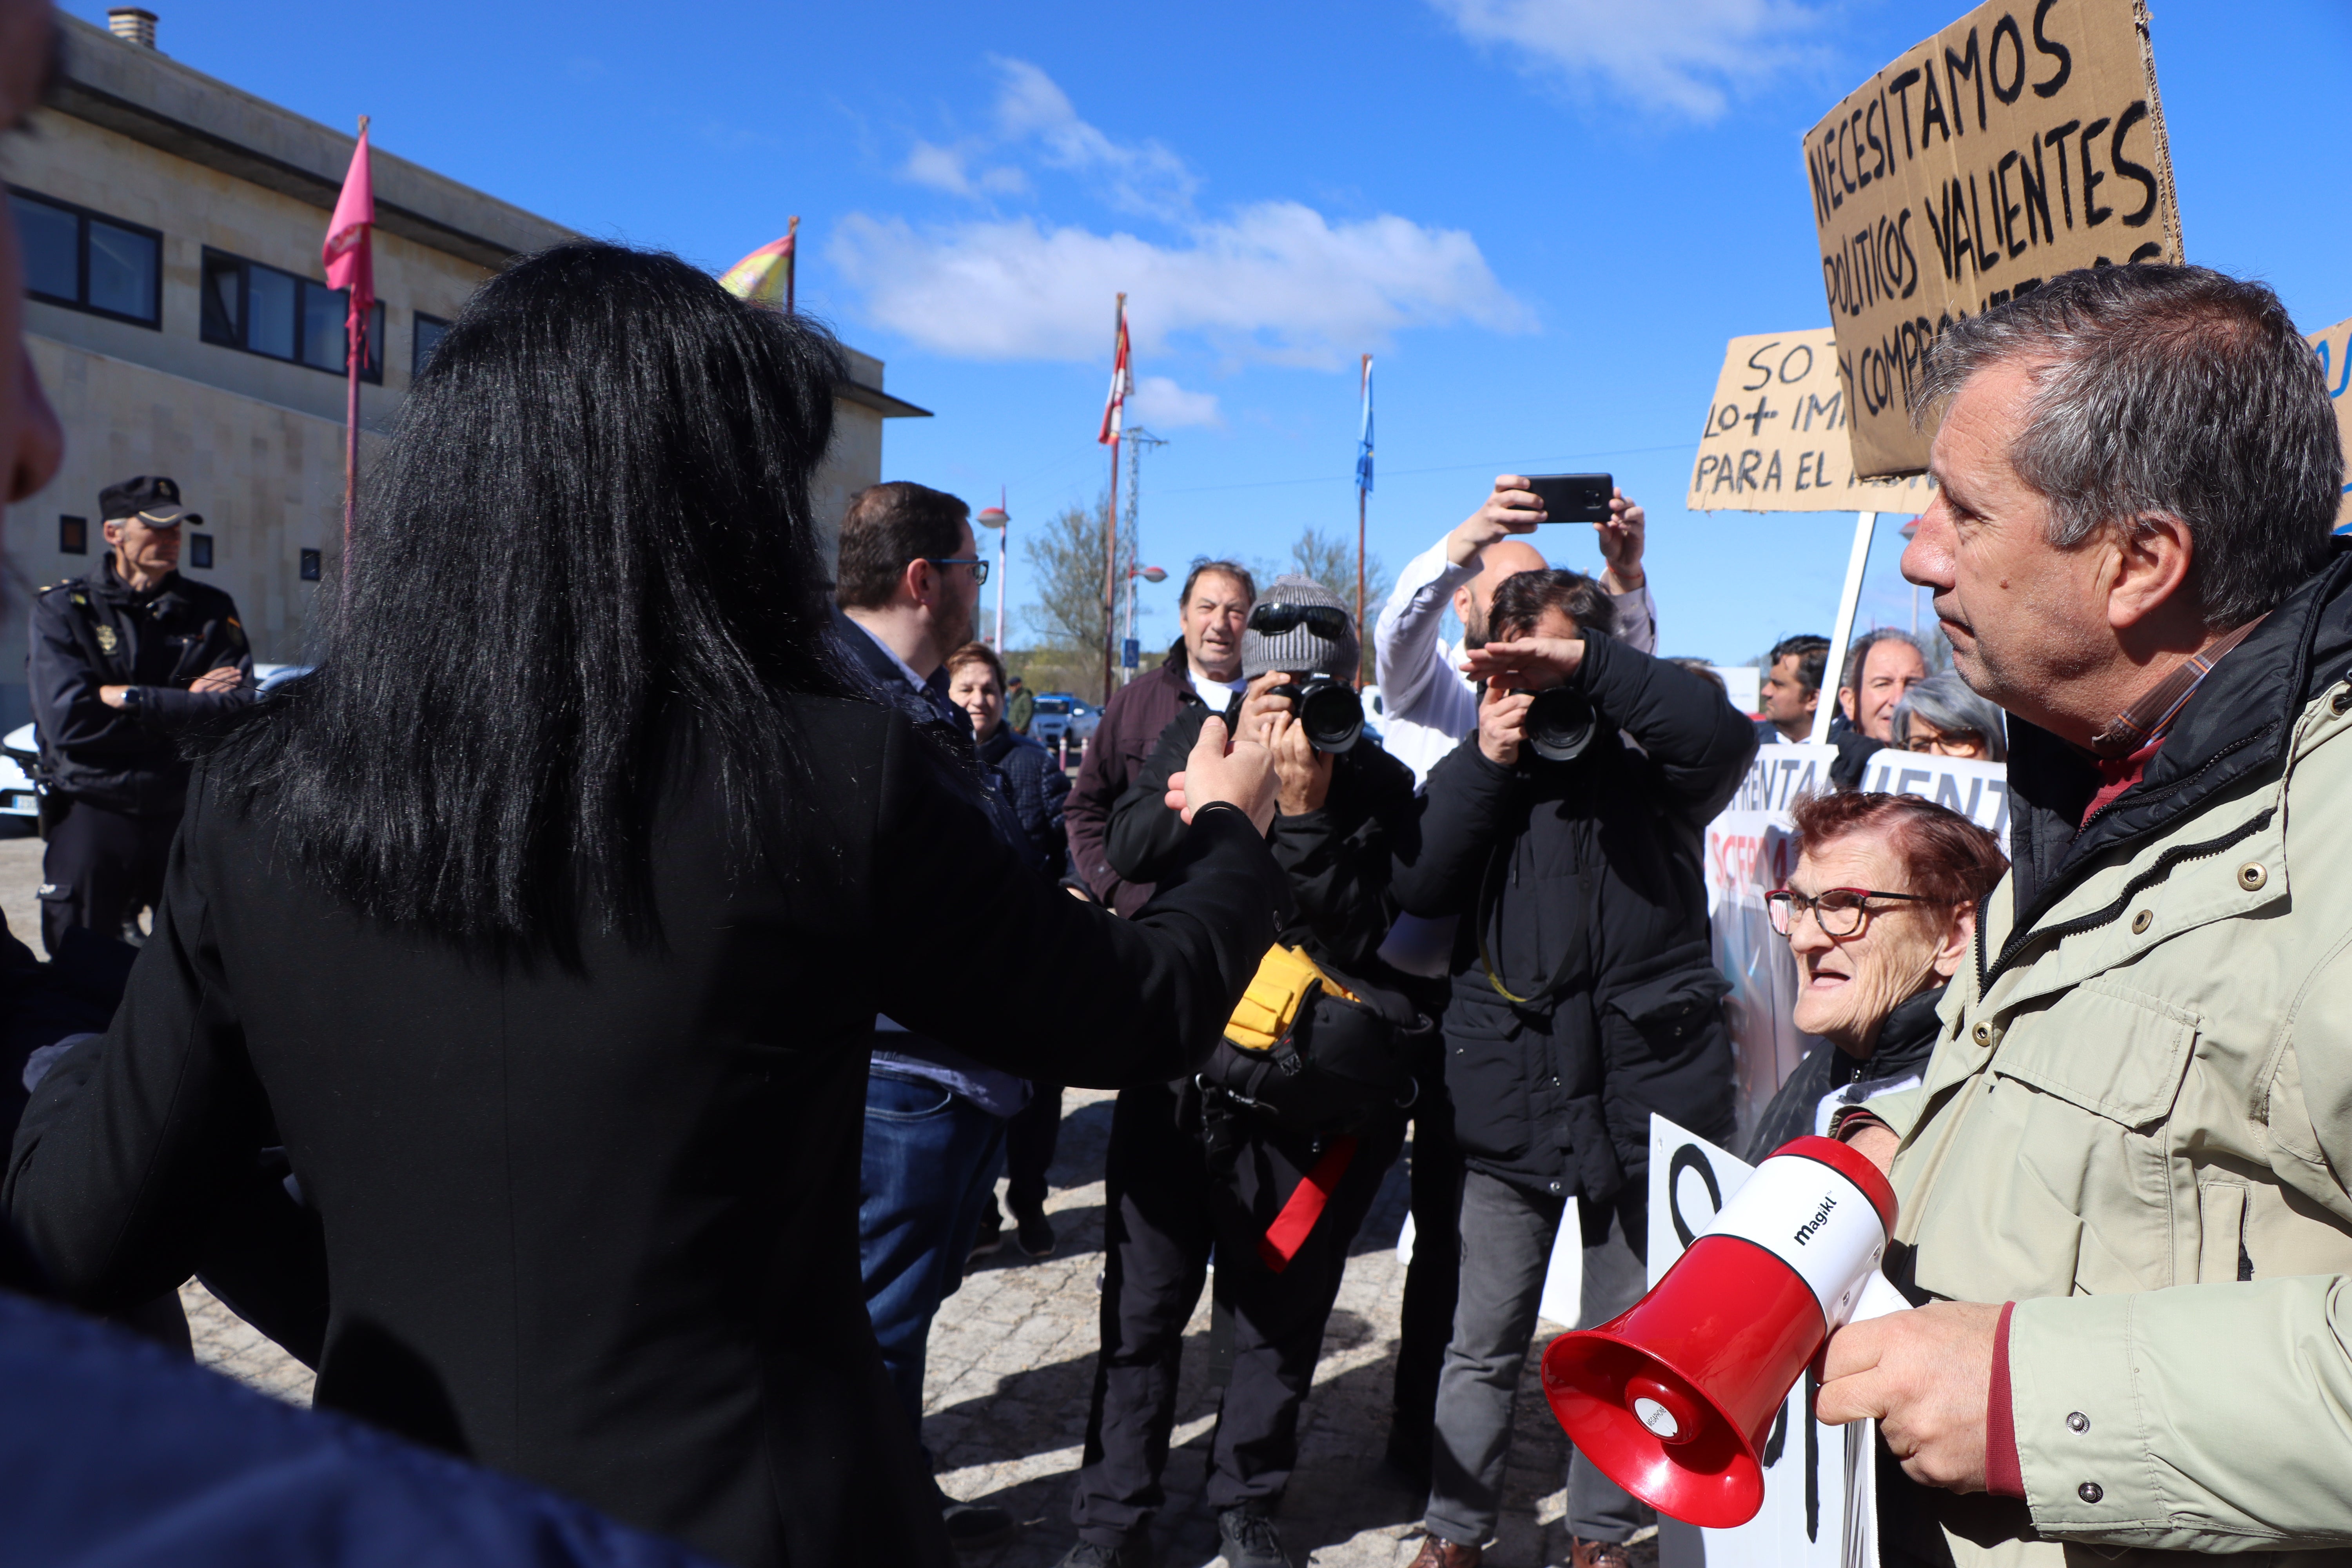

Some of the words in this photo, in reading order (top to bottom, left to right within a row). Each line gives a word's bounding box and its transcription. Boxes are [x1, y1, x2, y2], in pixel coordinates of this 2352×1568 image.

[1809, 0, 2071, 229] NECESITAMOS
[1824, 207, 1918, 332] POLITICOS
[1925, 100, 2157, 285] VALIENTES
[1839, 348, 1857, 430] Y
[1695, 449, 1782, 494] PARA
[1796, 451, 1832, 492] EL
[1646, 1406, 1667, 1427] MEGAPHONE
